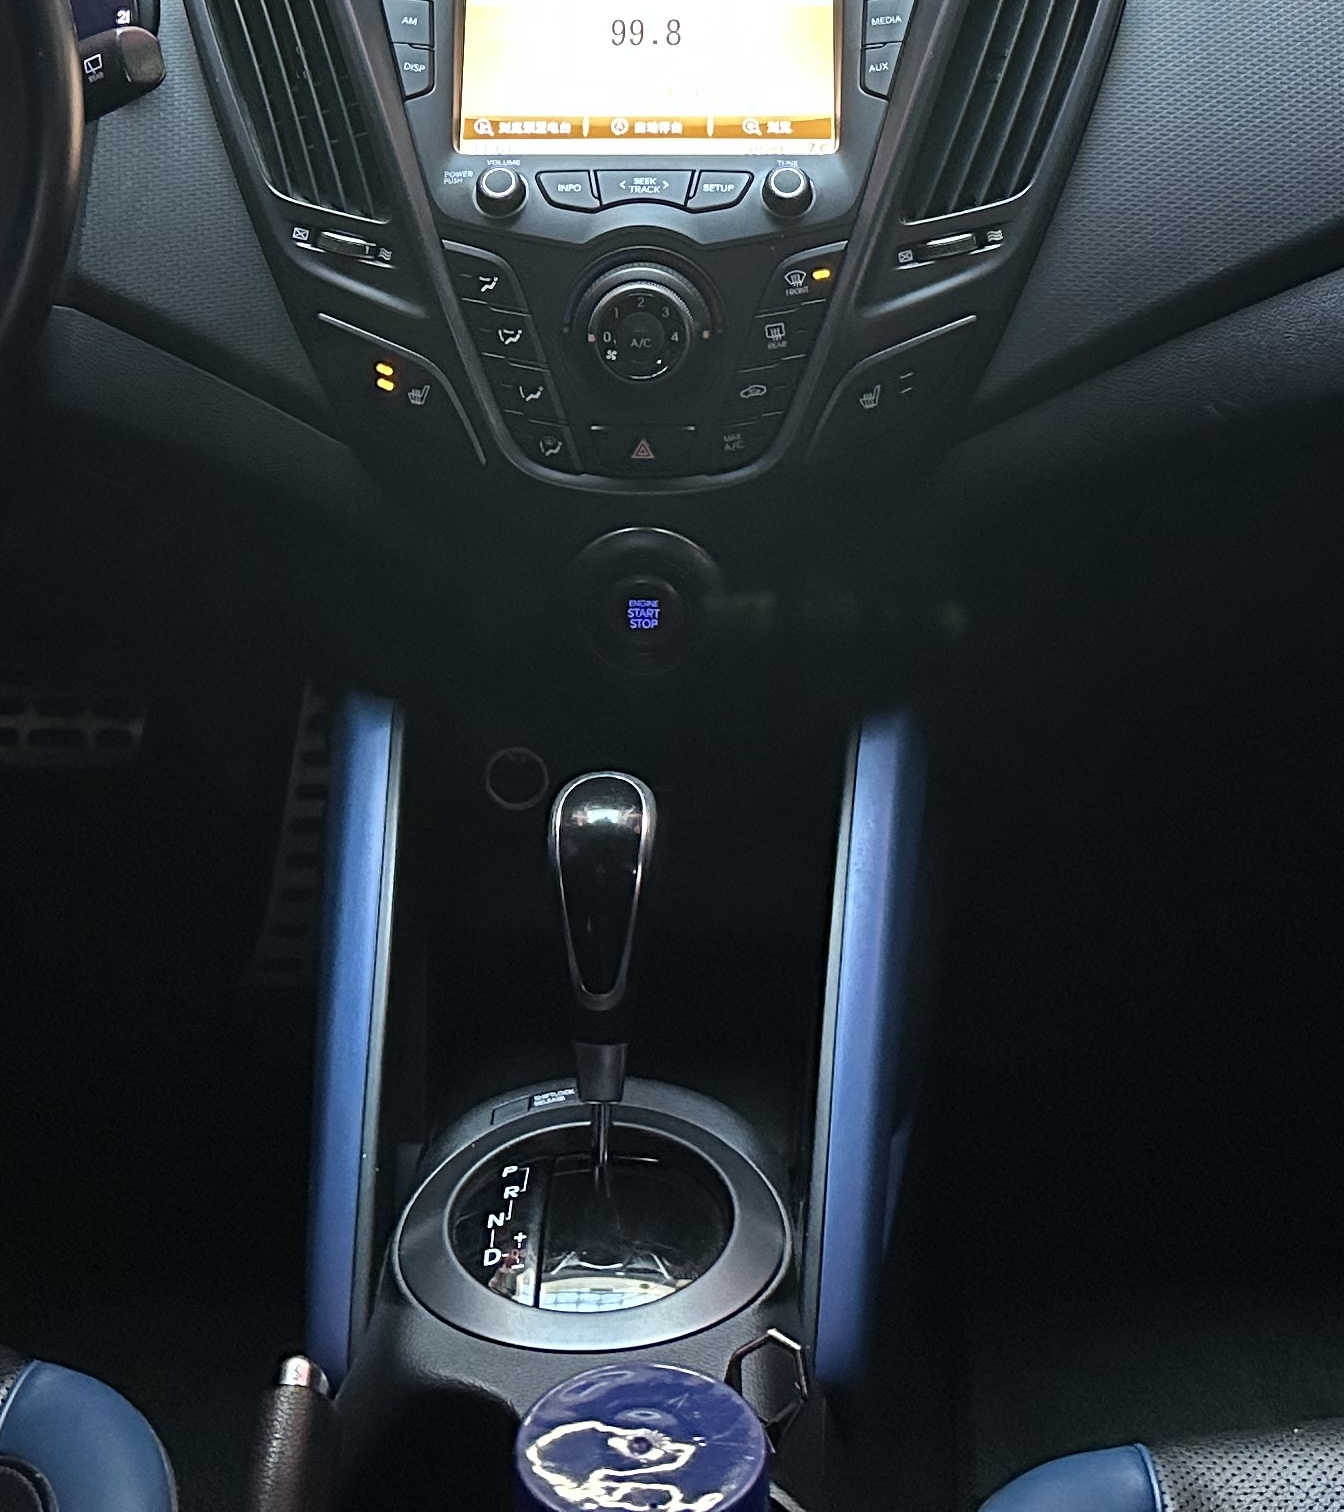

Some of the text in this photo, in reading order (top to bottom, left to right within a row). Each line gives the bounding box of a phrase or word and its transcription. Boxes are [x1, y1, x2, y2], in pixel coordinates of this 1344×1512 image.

[401, 16, 418, 26] AM
[871, 15, 902, 26] MEDIA
[610, 18, 682, 47] 99.8
[403, 61, 427, 73] DISP
[868, 61, 890, 73] AUX
[486, 159, 521, 167] VOLUME
[633, 177, 657, 185] SEEK
[557, 183, 582, 192] INFO
[628, 185, 661, 194] TRACK
[702, 183, 735, 193] SETUP
[637, 296, 645, 308] 2
[661, 307, 670, 318] 3
[670, 331, 679, 342] 4
[630, 337, 652, 348] A/C
[627, 607, 660, 618] START
[629, 618, 658, 629] STOP
[502, 1165, 518, 1178] P
[503, 1185, 520, 1199] R
[487, 1211, 505, 1229] N
[483, 1248, 502, 1267] D
